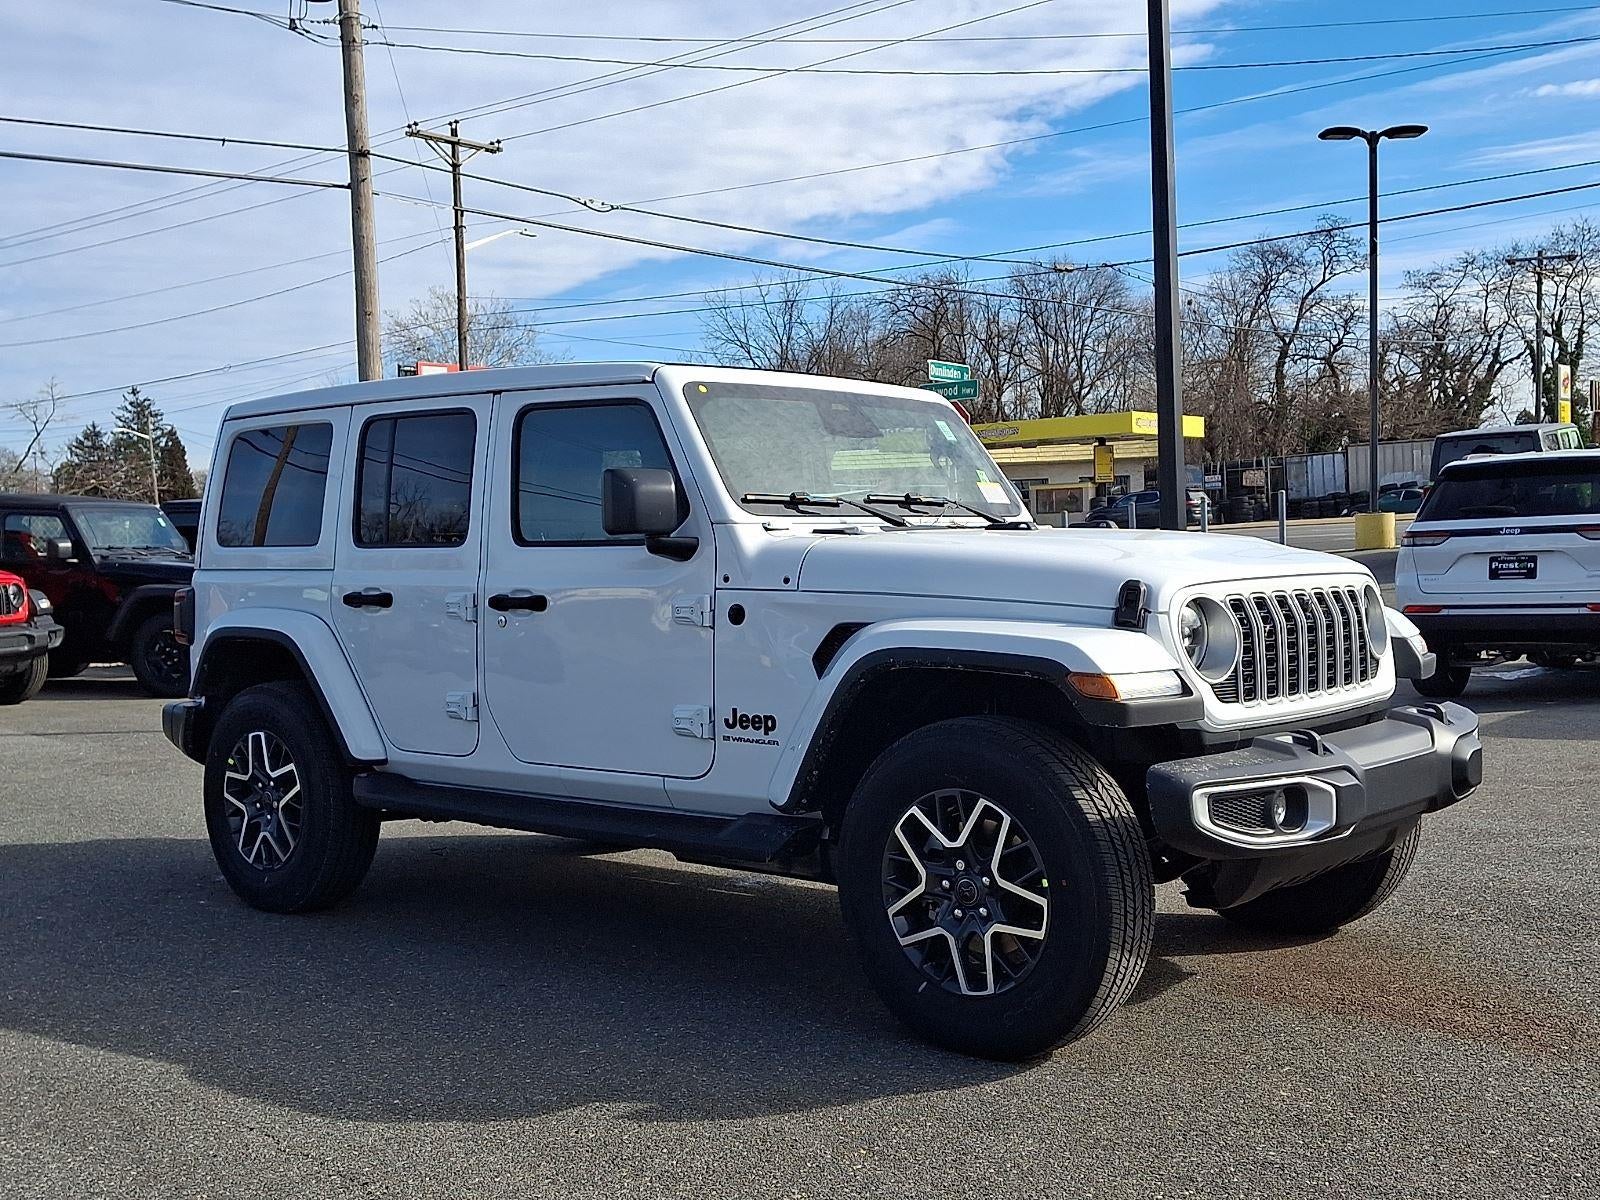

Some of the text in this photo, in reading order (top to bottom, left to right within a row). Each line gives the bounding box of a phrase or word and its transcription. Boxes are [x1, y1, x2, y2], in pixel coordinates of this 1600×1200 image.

[930, 363, 962, 379] Dunlinden
[961, 387, 975, 395] Hwy
[1499, 527, 1521, 535] Jeep
[723, 707, 777, 736] Jeep
[730, 735, 780, 747] WRANGLER
